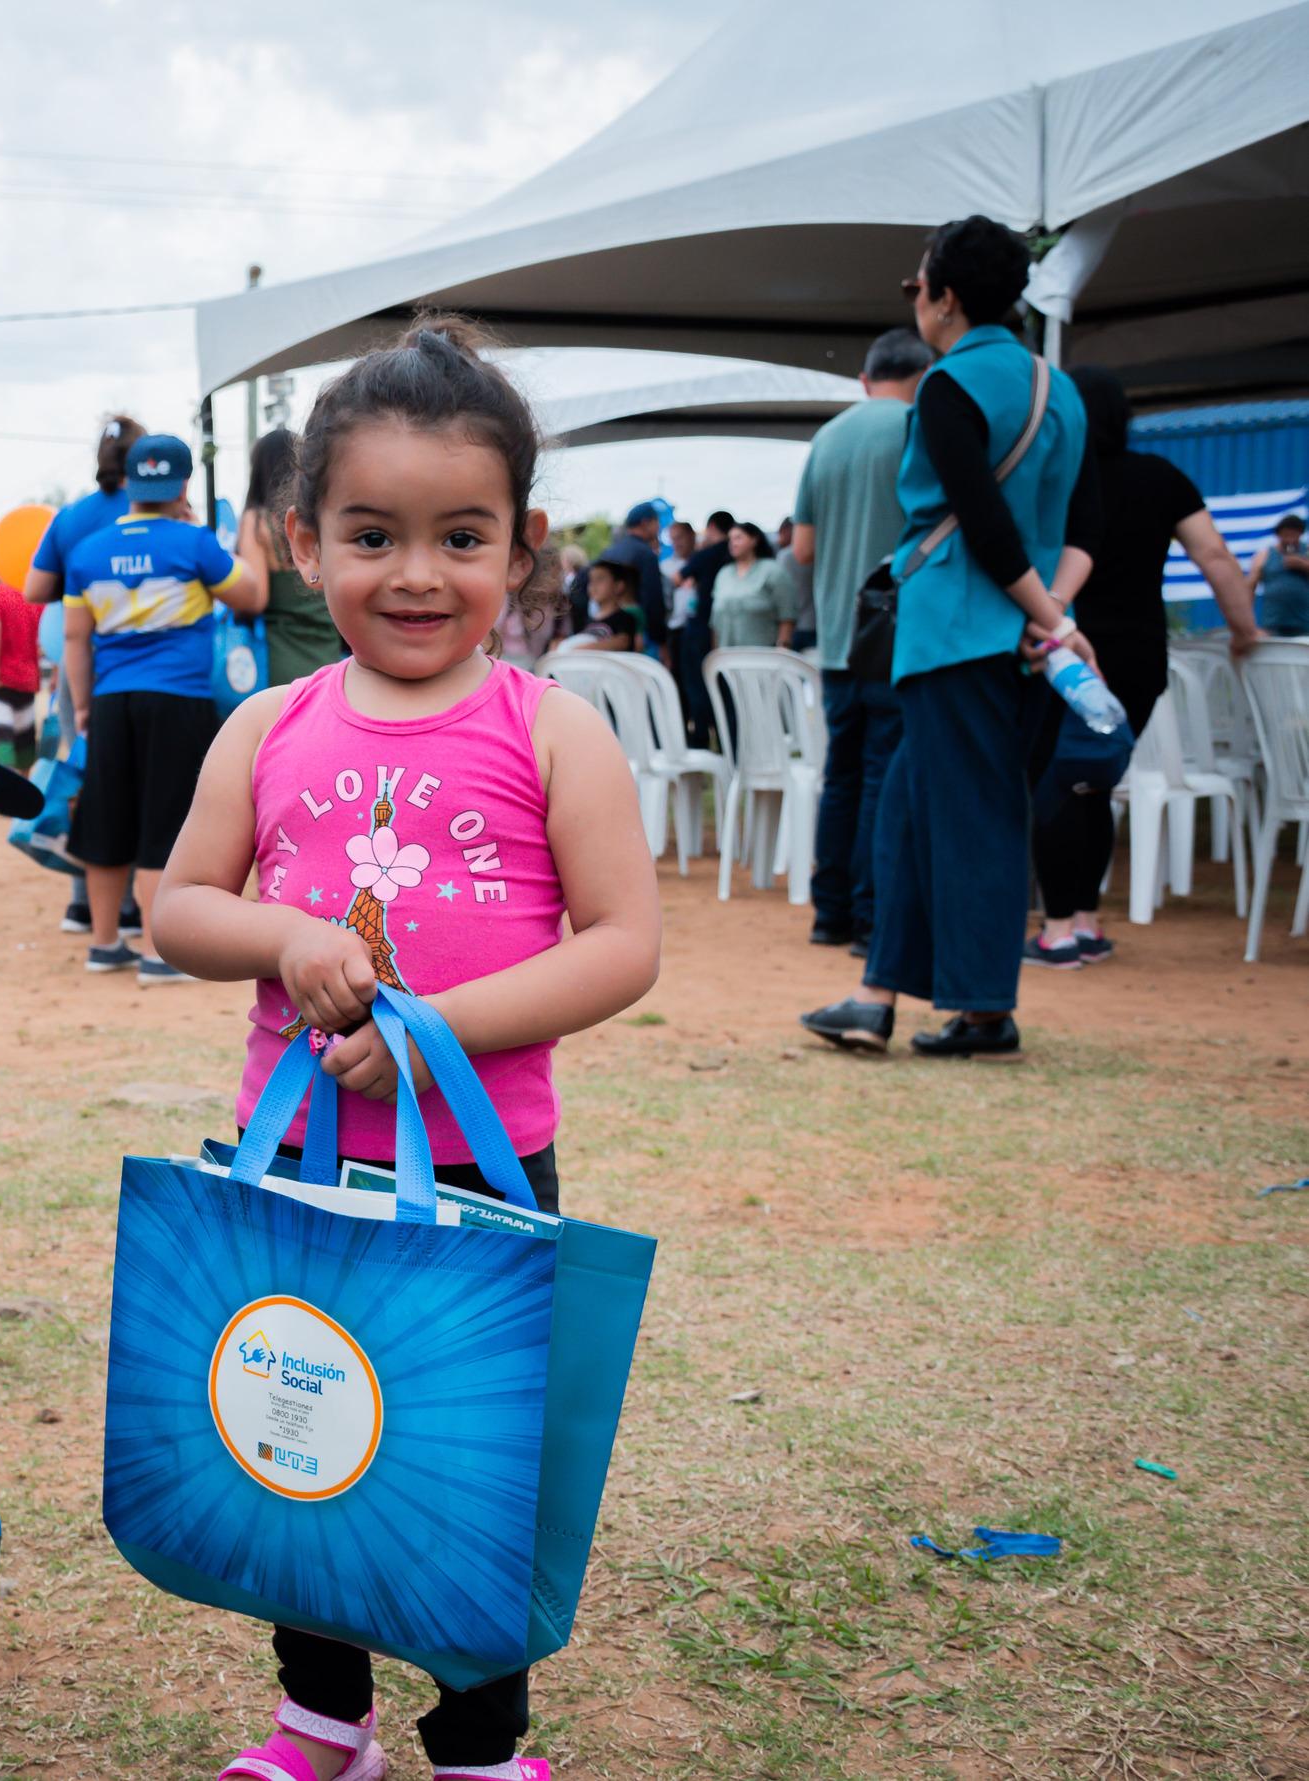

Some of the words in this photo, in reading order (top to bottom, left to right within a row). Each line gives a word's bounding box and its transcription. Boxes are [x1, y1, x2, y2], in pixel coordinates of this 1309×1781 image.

[110, 554, 153, 575] VILLA
[267, 825, 299, 901] MY
[299, 765, 442, 821] LOVE
[449, 809, 508, 904] ONE
[282, 1351, 346, 1382] Inclusión
[281, 1370, 323, 1395] Social
[268, 1392, 313, 1411] Telegestiones
[271, 1408, 290, 1419] 0800
[291, 1413, 308, 1424] 1930
[274, 1446, 318, 1476] UTE
